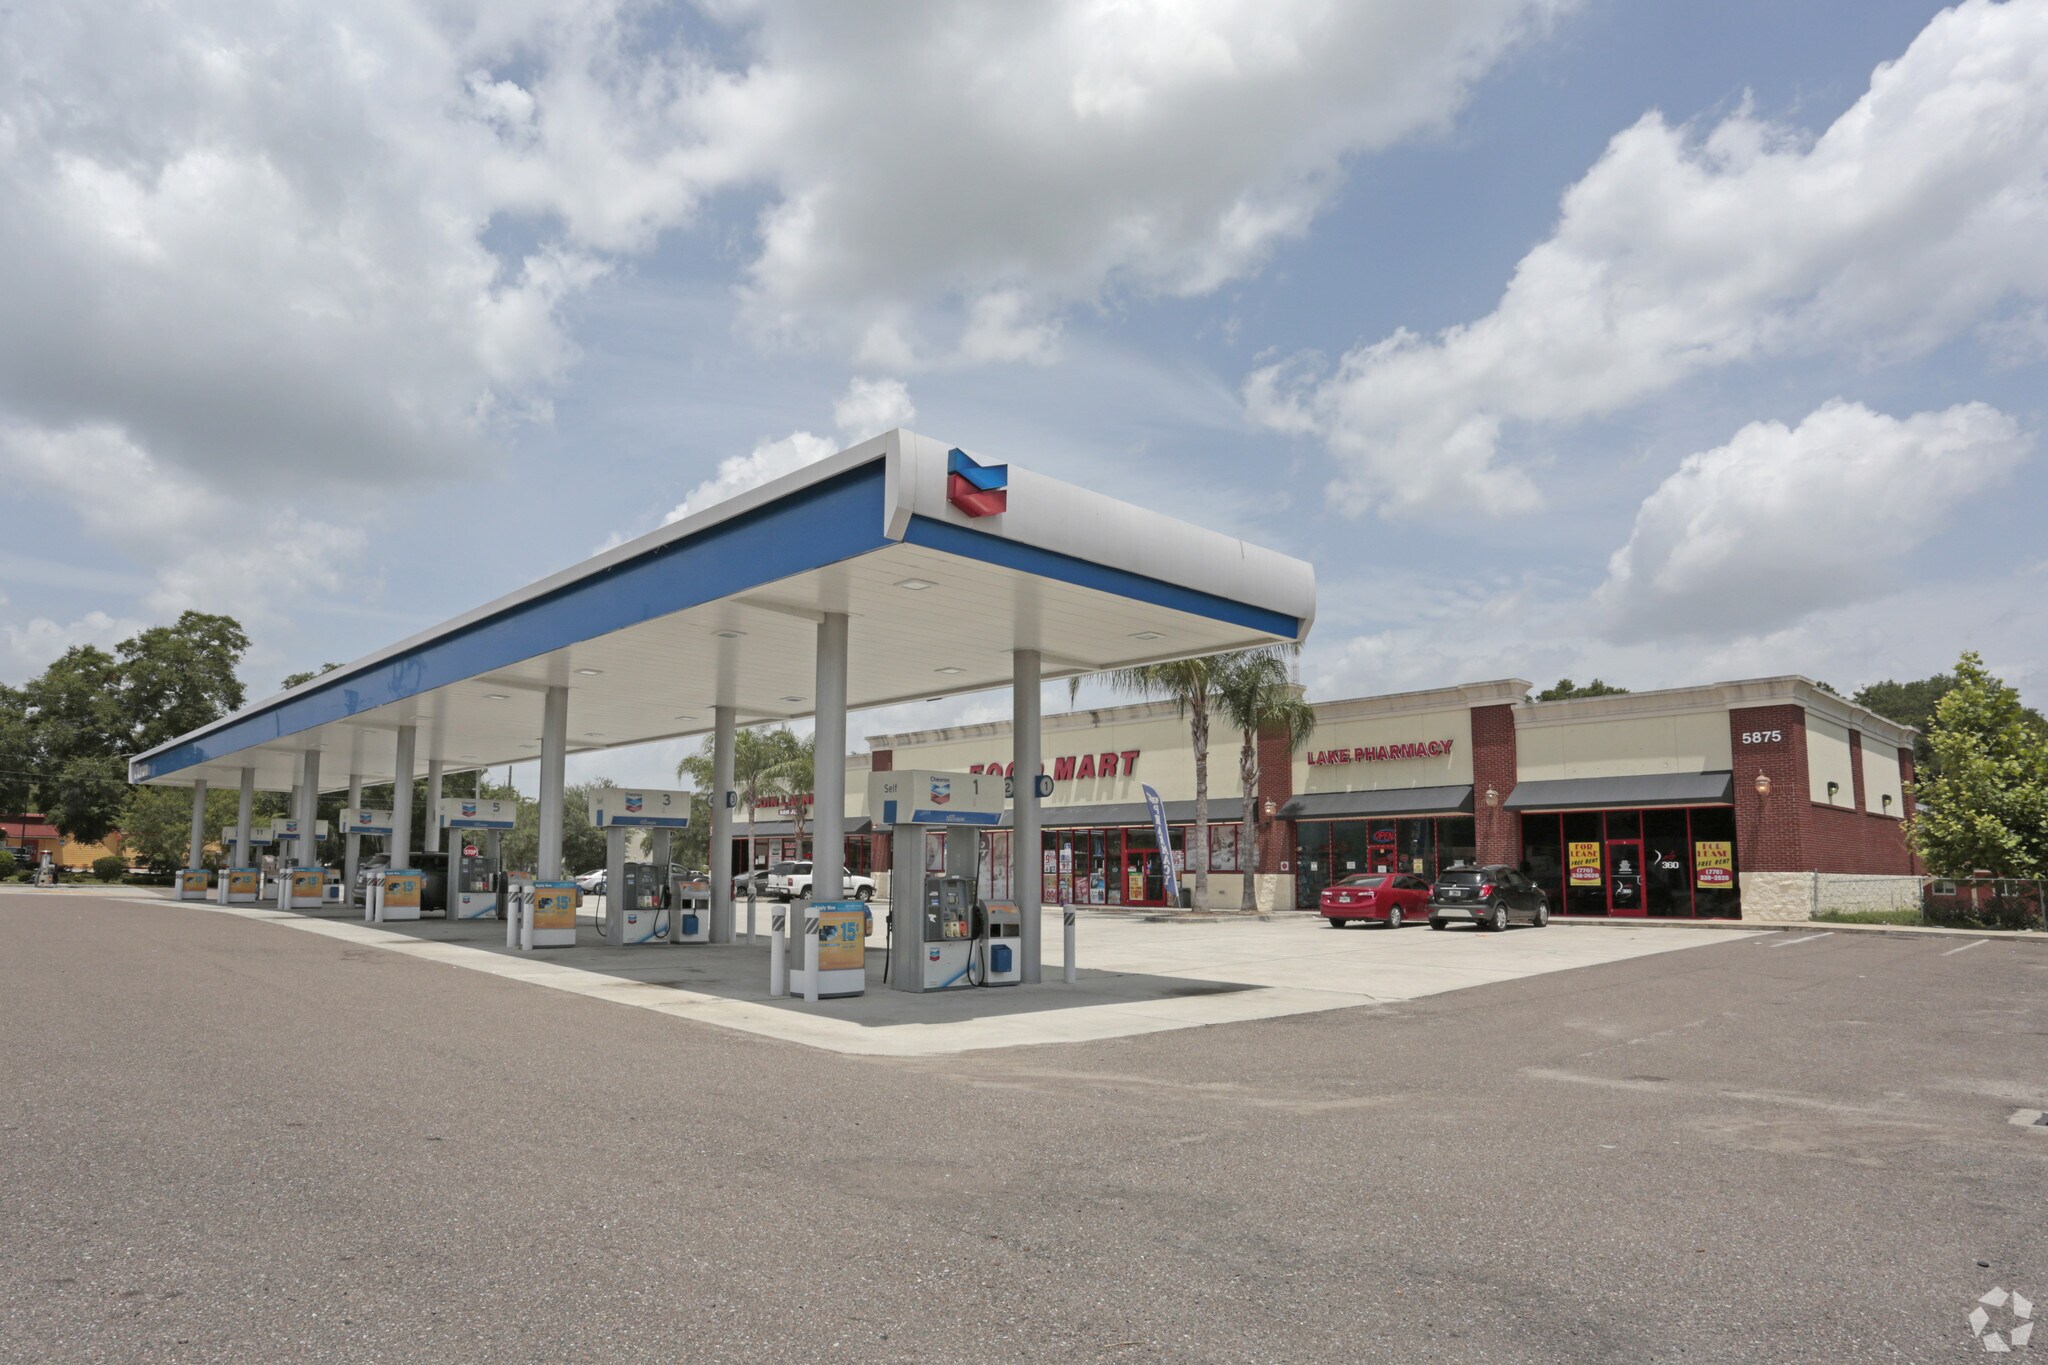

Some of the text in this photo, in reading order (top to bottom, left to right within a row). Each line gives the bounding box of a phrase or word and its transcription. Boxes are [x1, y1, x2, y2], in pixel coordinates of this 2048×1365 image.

[1742, 730, 1782, 744] 5875
[1307, 739, 1453, 765] LAKE PHARMACY
[1053, 750, 1140, 781] MART
[884, 783, 897, 793] Self
[973, 779, 978, 795] 1
[662, 794, 671, 806] 3
[493, 803, 500, 812] 5
[386, 812, 392, 821] 7
[1375, 831, 1395, 840] OPEN
[1662, 861, 1679, 869] 360
